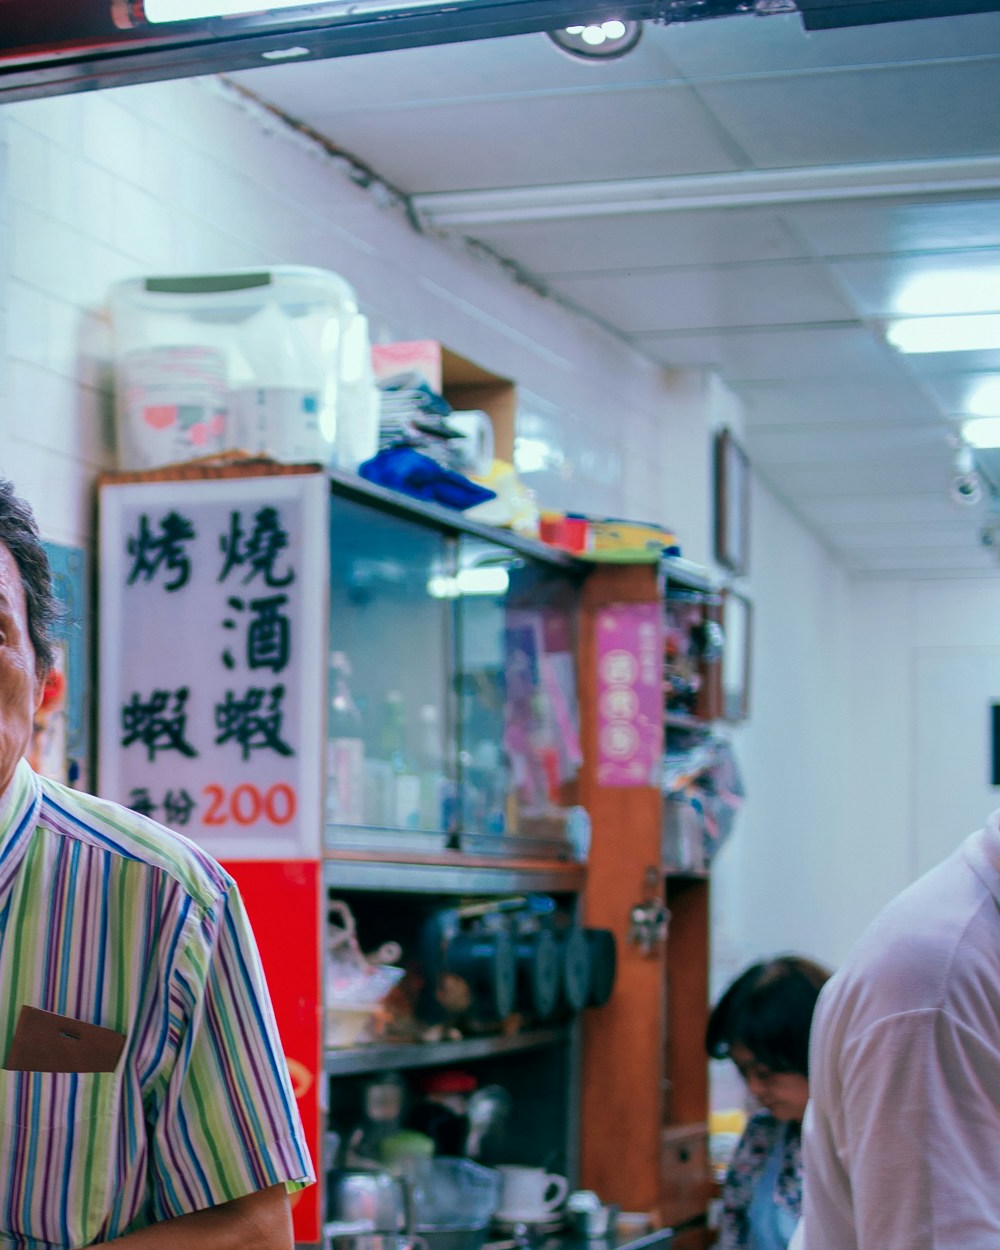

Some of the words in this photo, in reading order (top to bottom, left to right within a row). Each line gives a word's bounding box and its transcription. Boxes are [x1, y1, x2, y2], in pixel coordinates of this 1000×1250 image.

[121, 510, 198, 761] 烤蝦
[214, 506, 296, 761] 燒酒蝦
[201, 783, 297, 826] 200
